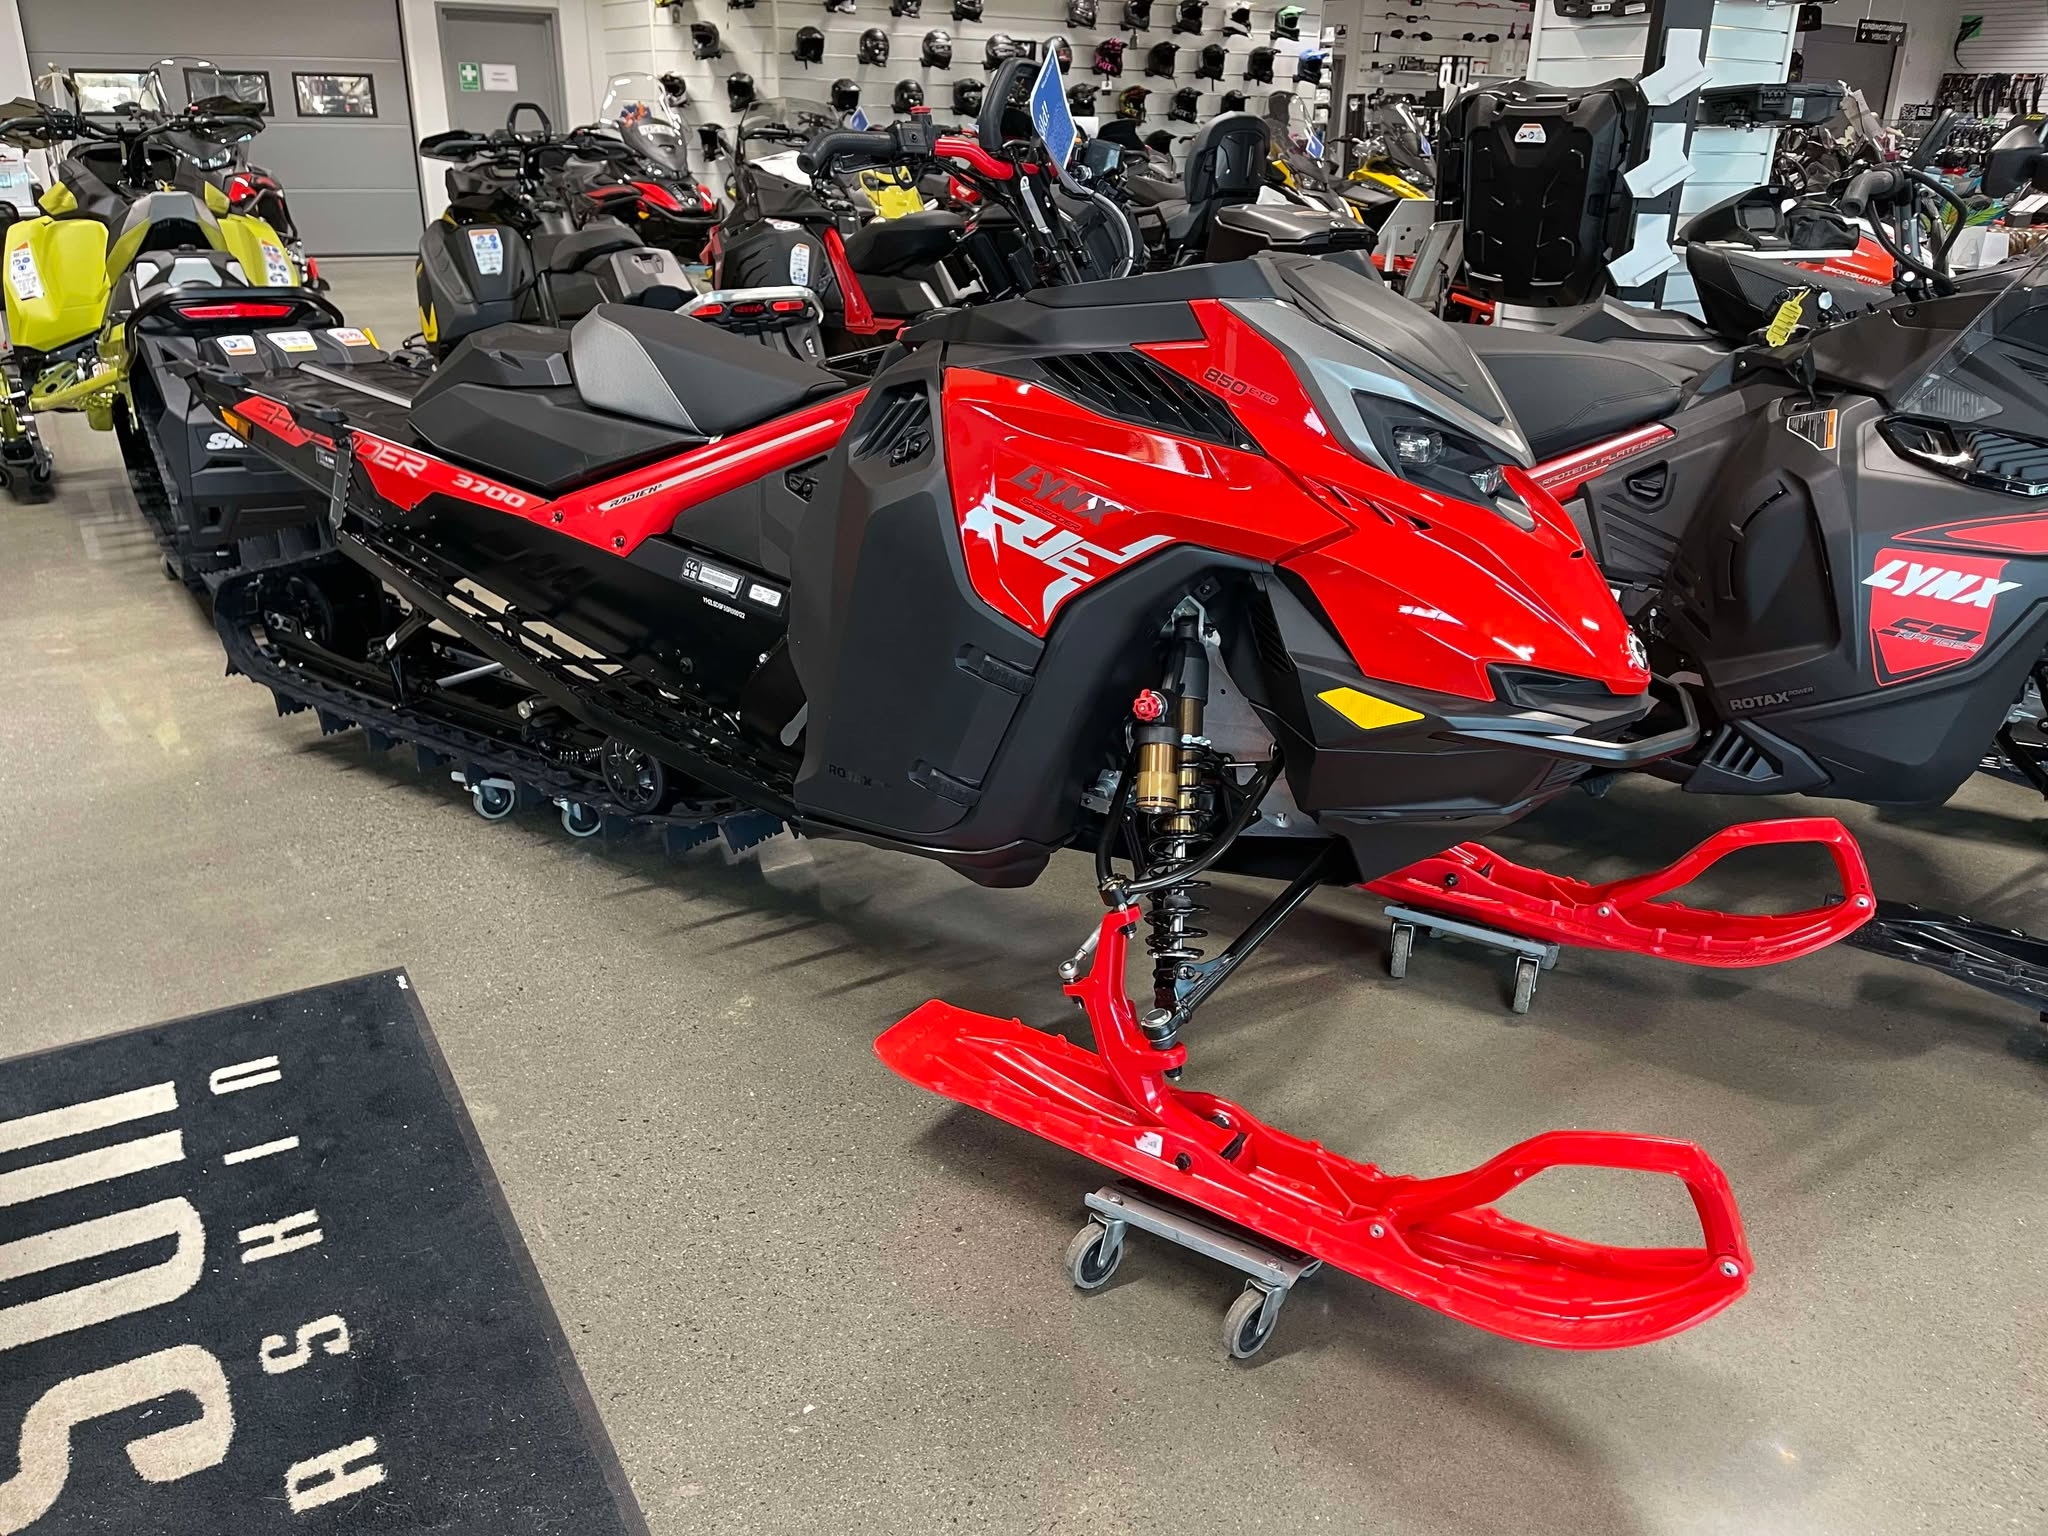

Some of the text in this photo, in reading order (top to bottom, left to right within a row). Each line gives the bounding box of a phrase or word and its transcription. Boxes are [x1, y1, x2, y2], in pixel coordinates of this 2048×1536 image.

[1822, 265, 1884, 285] BACKCOUNTRY
[1204, 367, 1278, 404] 850 E-TEC
[1600, 434, 1666, 464] PLATFORM
[452, 473, 526, 508] 3700
[1010, 464, 1122, 526] LYNX
[1020, 497, 1081, 531] SHREDDER
[1861, 559, 2023, 609] LYNX
[1729, 686, 1815, 711] ROTAX POWER
